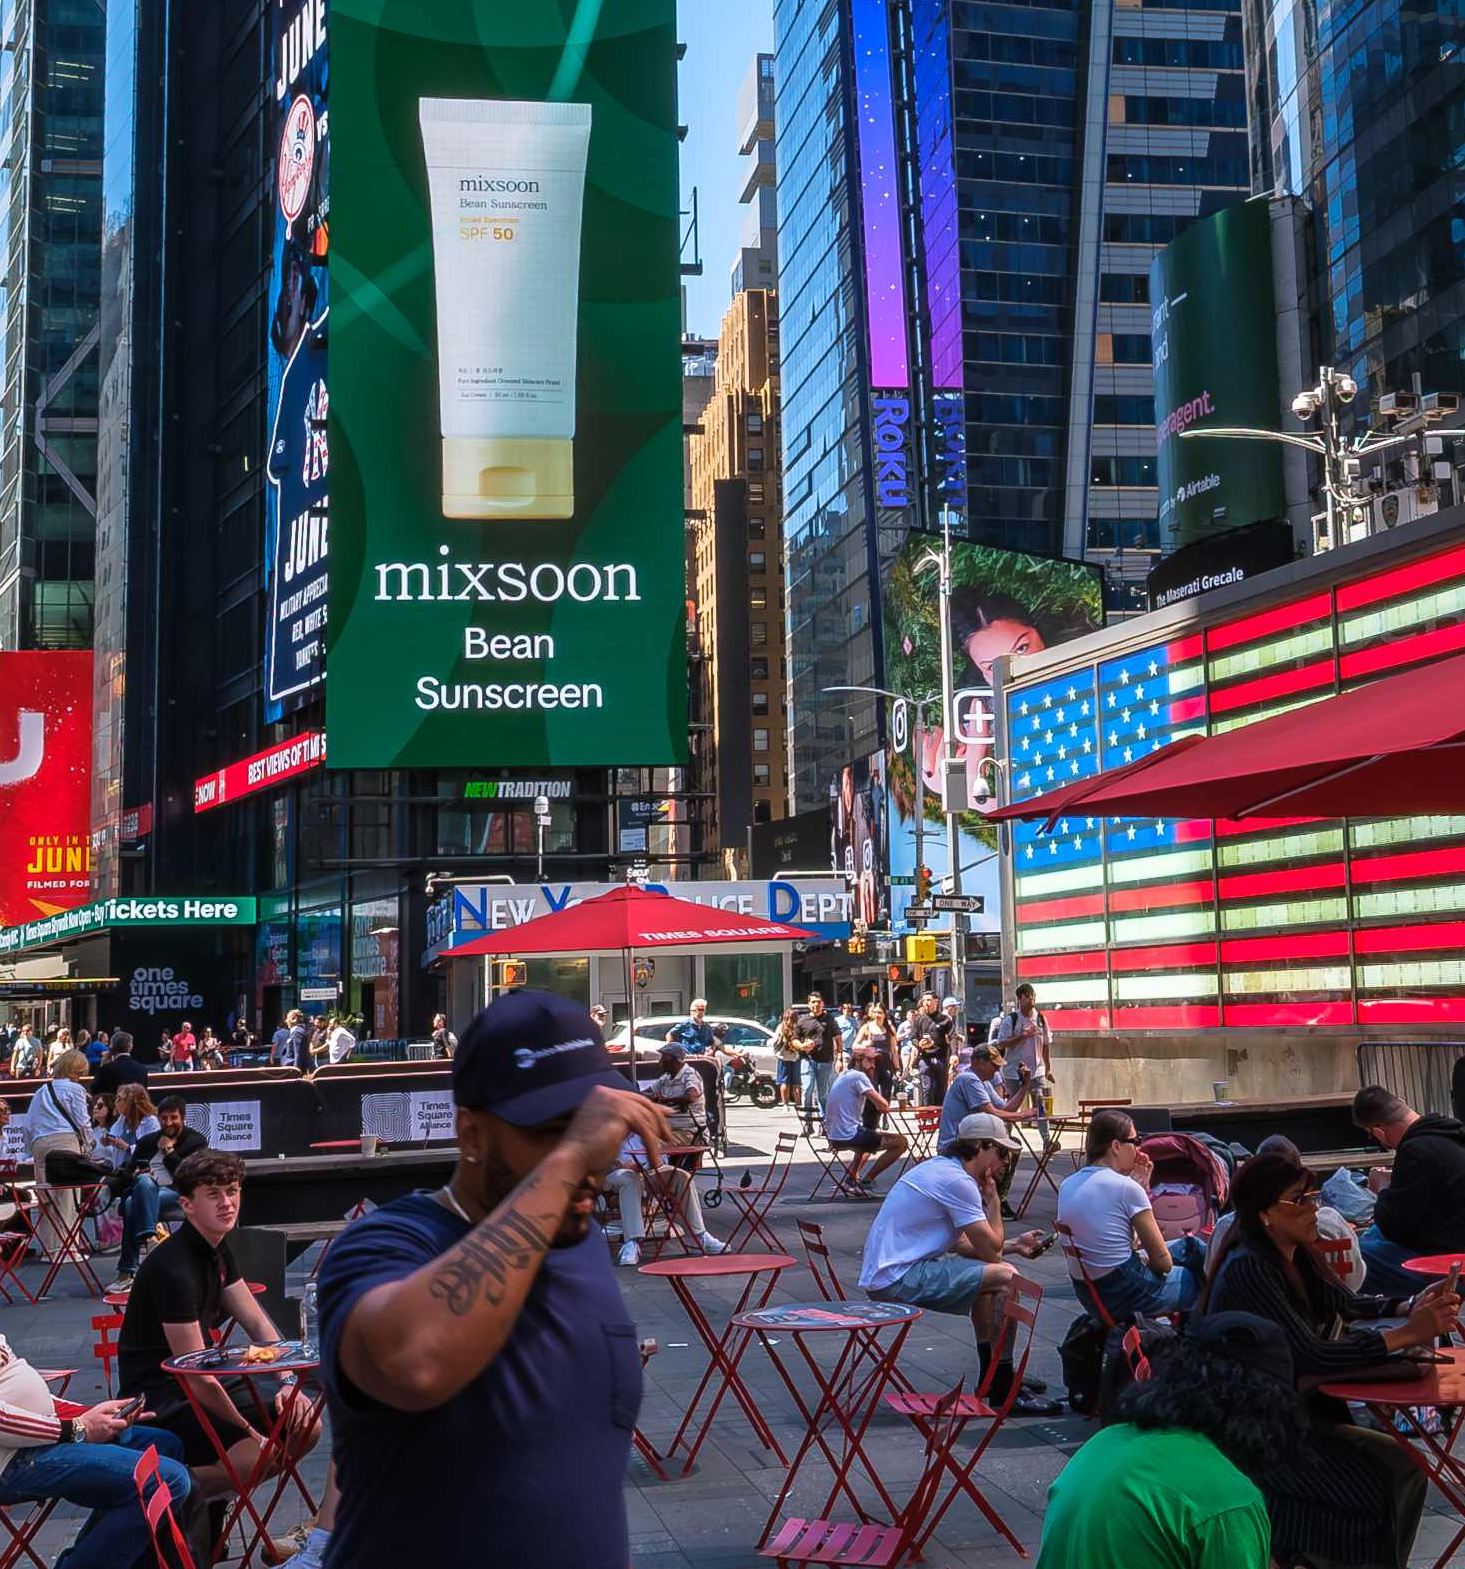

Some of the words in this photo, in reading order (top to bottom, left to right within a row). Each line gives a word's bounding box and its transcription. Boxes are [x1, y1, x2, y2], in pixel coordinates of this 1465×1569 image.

[459, 175, 540, 193] mixsoon
[459, 198, 487, 209] Bean
[491, 199, 547, 210] Sunscreen
[459, 228, 488, 240] SPF
[492, 228, 513, 241] 50
[874, 399, 909, 507] ROKU
[1186, 473, 1220, 497] Airtable
[373, 544, 640, 603] mixsoon
[1157, 589, 1166, 609] The
[1166, 577, 1200, 604] Maserati
[1202, 566, 1244, 592] Grecale
[465, 627, 554, 662] Bean
[414, 676, 603, 711] Sunscreen
[248, 761, 265, 785] BEST
[267, 750, 290, 777] VIEWS
[290, 745, 302, 767] OF
[29, 835, 59, 846] ONLY
[66, 835, 82, 846] IN
[27, 880, 66, 889] FILMED
[105, 898, 178, 920] Tickets
[184, 900, 238, 919] Here
[454, 886, 535, 931] NEW
[768, 881, 854, 924] DEPT
[960, 900, 976, 908] WAY
[638, 930, 701, 941] TIMES
[704, 925, 790, 938] SQUARE
[134, 967, 174, 981] one
[130, 979, 188, 995] times
[130, 993, 204, 1015] square
[418, 1099, 451, 1111] Times
[219, 1112, 251, 1122] Times
[417, 1110, 453, 1123] Square
[216, 1122, 253, 1133] Square
[420, 1120, 452, 1131] Alliance
[219, 1133, 252, 1142] Alliance
